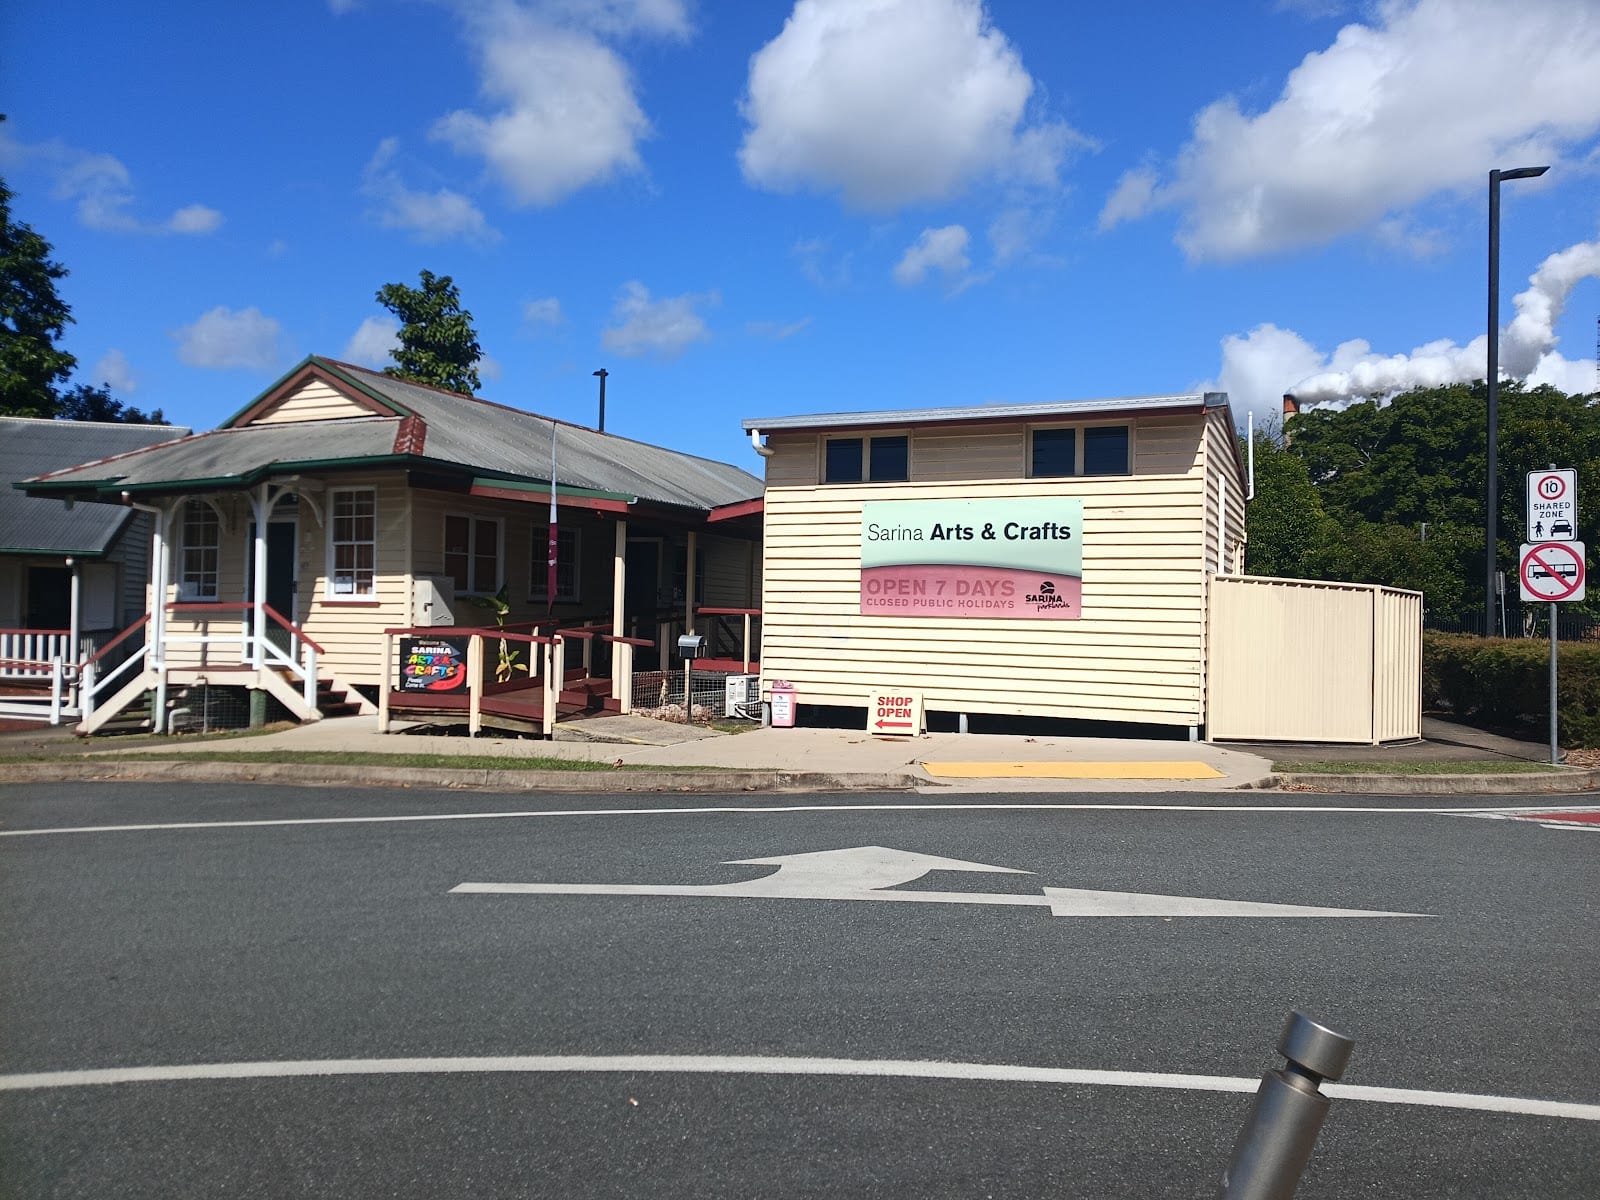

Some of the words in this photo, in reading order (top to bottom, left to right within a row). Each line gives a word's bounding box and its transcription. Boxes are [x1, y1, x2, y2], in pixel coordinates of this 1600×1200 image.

[1545, 482, 1558, 493] 10
[1533, 502, 1571, 510] SHARED
[867, 523, 924, 541] Sarina
[930, 523, 974, 540] Arts
[981, 522, 996, 540] &
[1003, 522, 1071, 540] Crafts
[866, 578, 926, 596] OPEN
[935, 579, 947, 596] 7
[956, 579, 1016, 597] DAYS
[866, 598, 909, 607] CLOSED
[912, 598, 953, 608] PUBLIC
[957, 599, 1015, 609] HOLIDAYS
[1025, 594, 1063, 603] SARINA
[411, 646, 452, 655] SARINA
[408, 654, 440, 666] ARTS
[405, 664, 455, 677] CRAFTS
[877, 696, 914, 707] SHOP
[877, 707, 912, 718] OPEN
